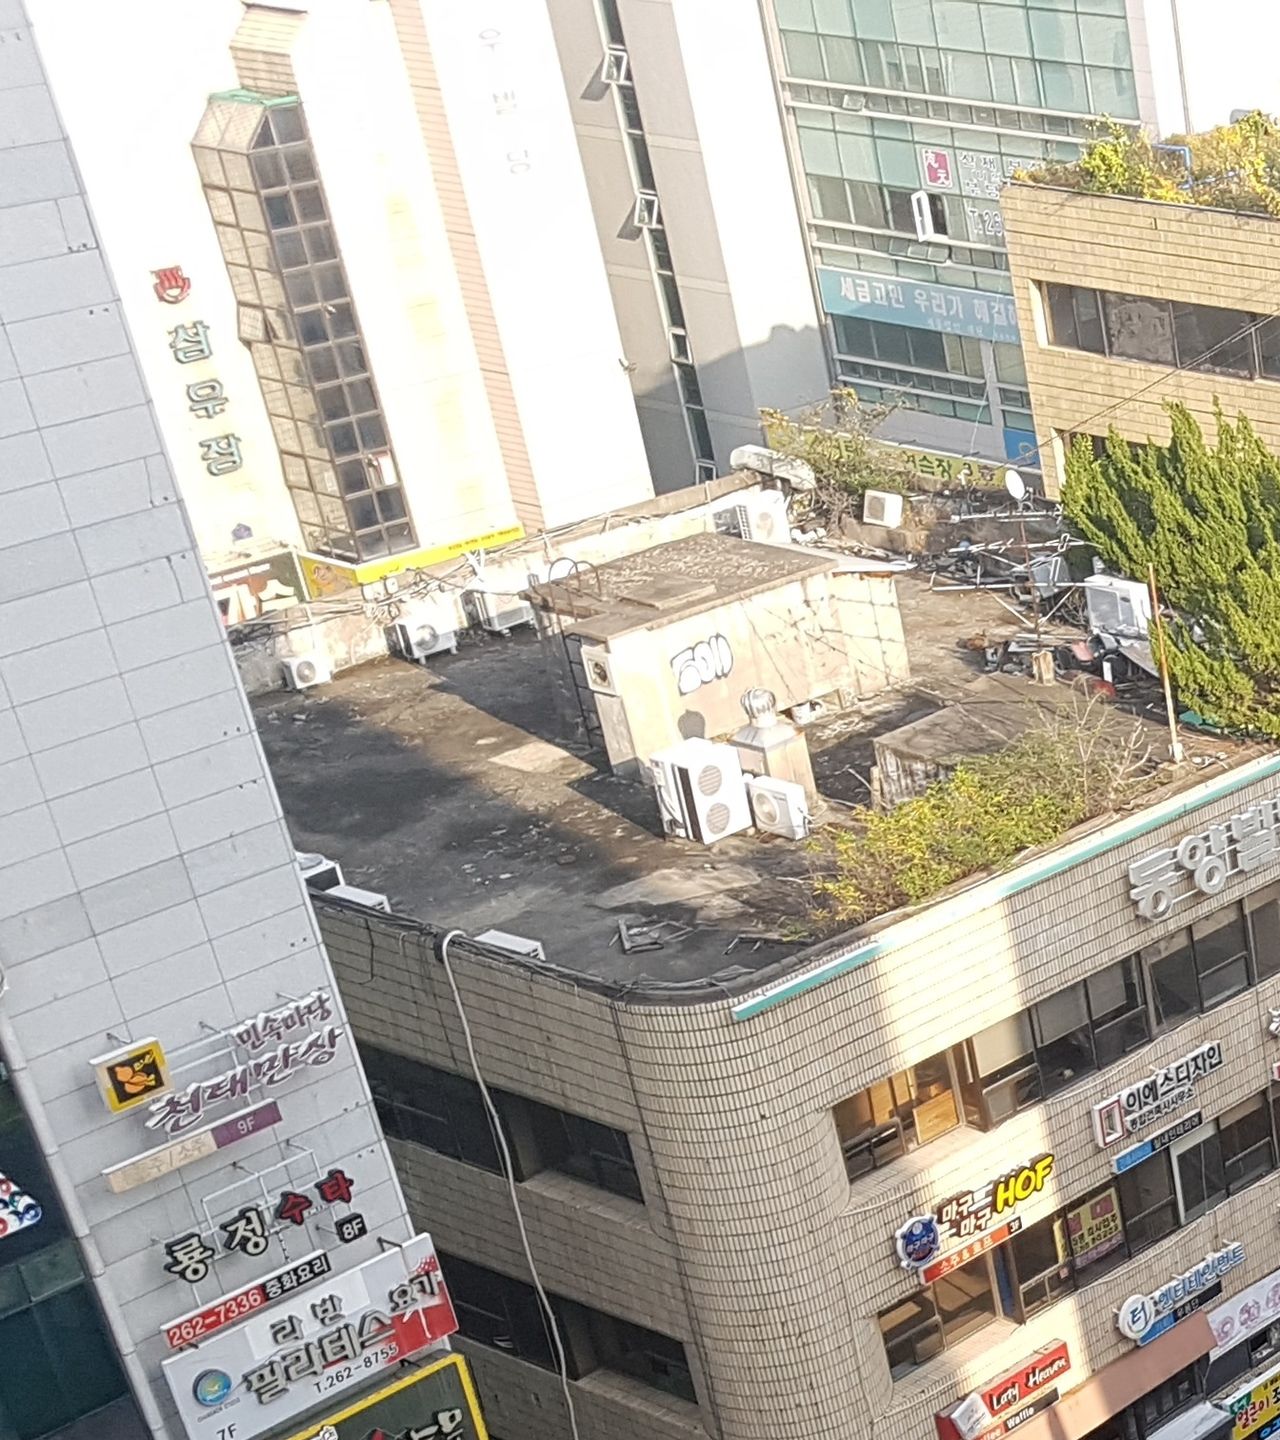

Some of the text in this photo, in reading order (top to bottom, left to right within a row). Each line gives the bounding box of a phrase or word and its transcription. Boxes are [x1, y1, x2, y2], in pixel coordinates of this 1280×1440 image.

[1123, 1040, 1224, 1112] 이에스디자인
[236, 1117, 256, 1135] 9F
[995, 1153, 1055, 1213] HOF
[342, 1218, 363, 1240] 8F
[264, 1258, 331, 1300] 중화요리
[387, 1272, 445, 1315] 요가
[167, 1288, 263, 1348] 262-7336
[245, 1308, 400, 1407] 필라테스
[312, 1343, 400, 1396] T.262-8755
